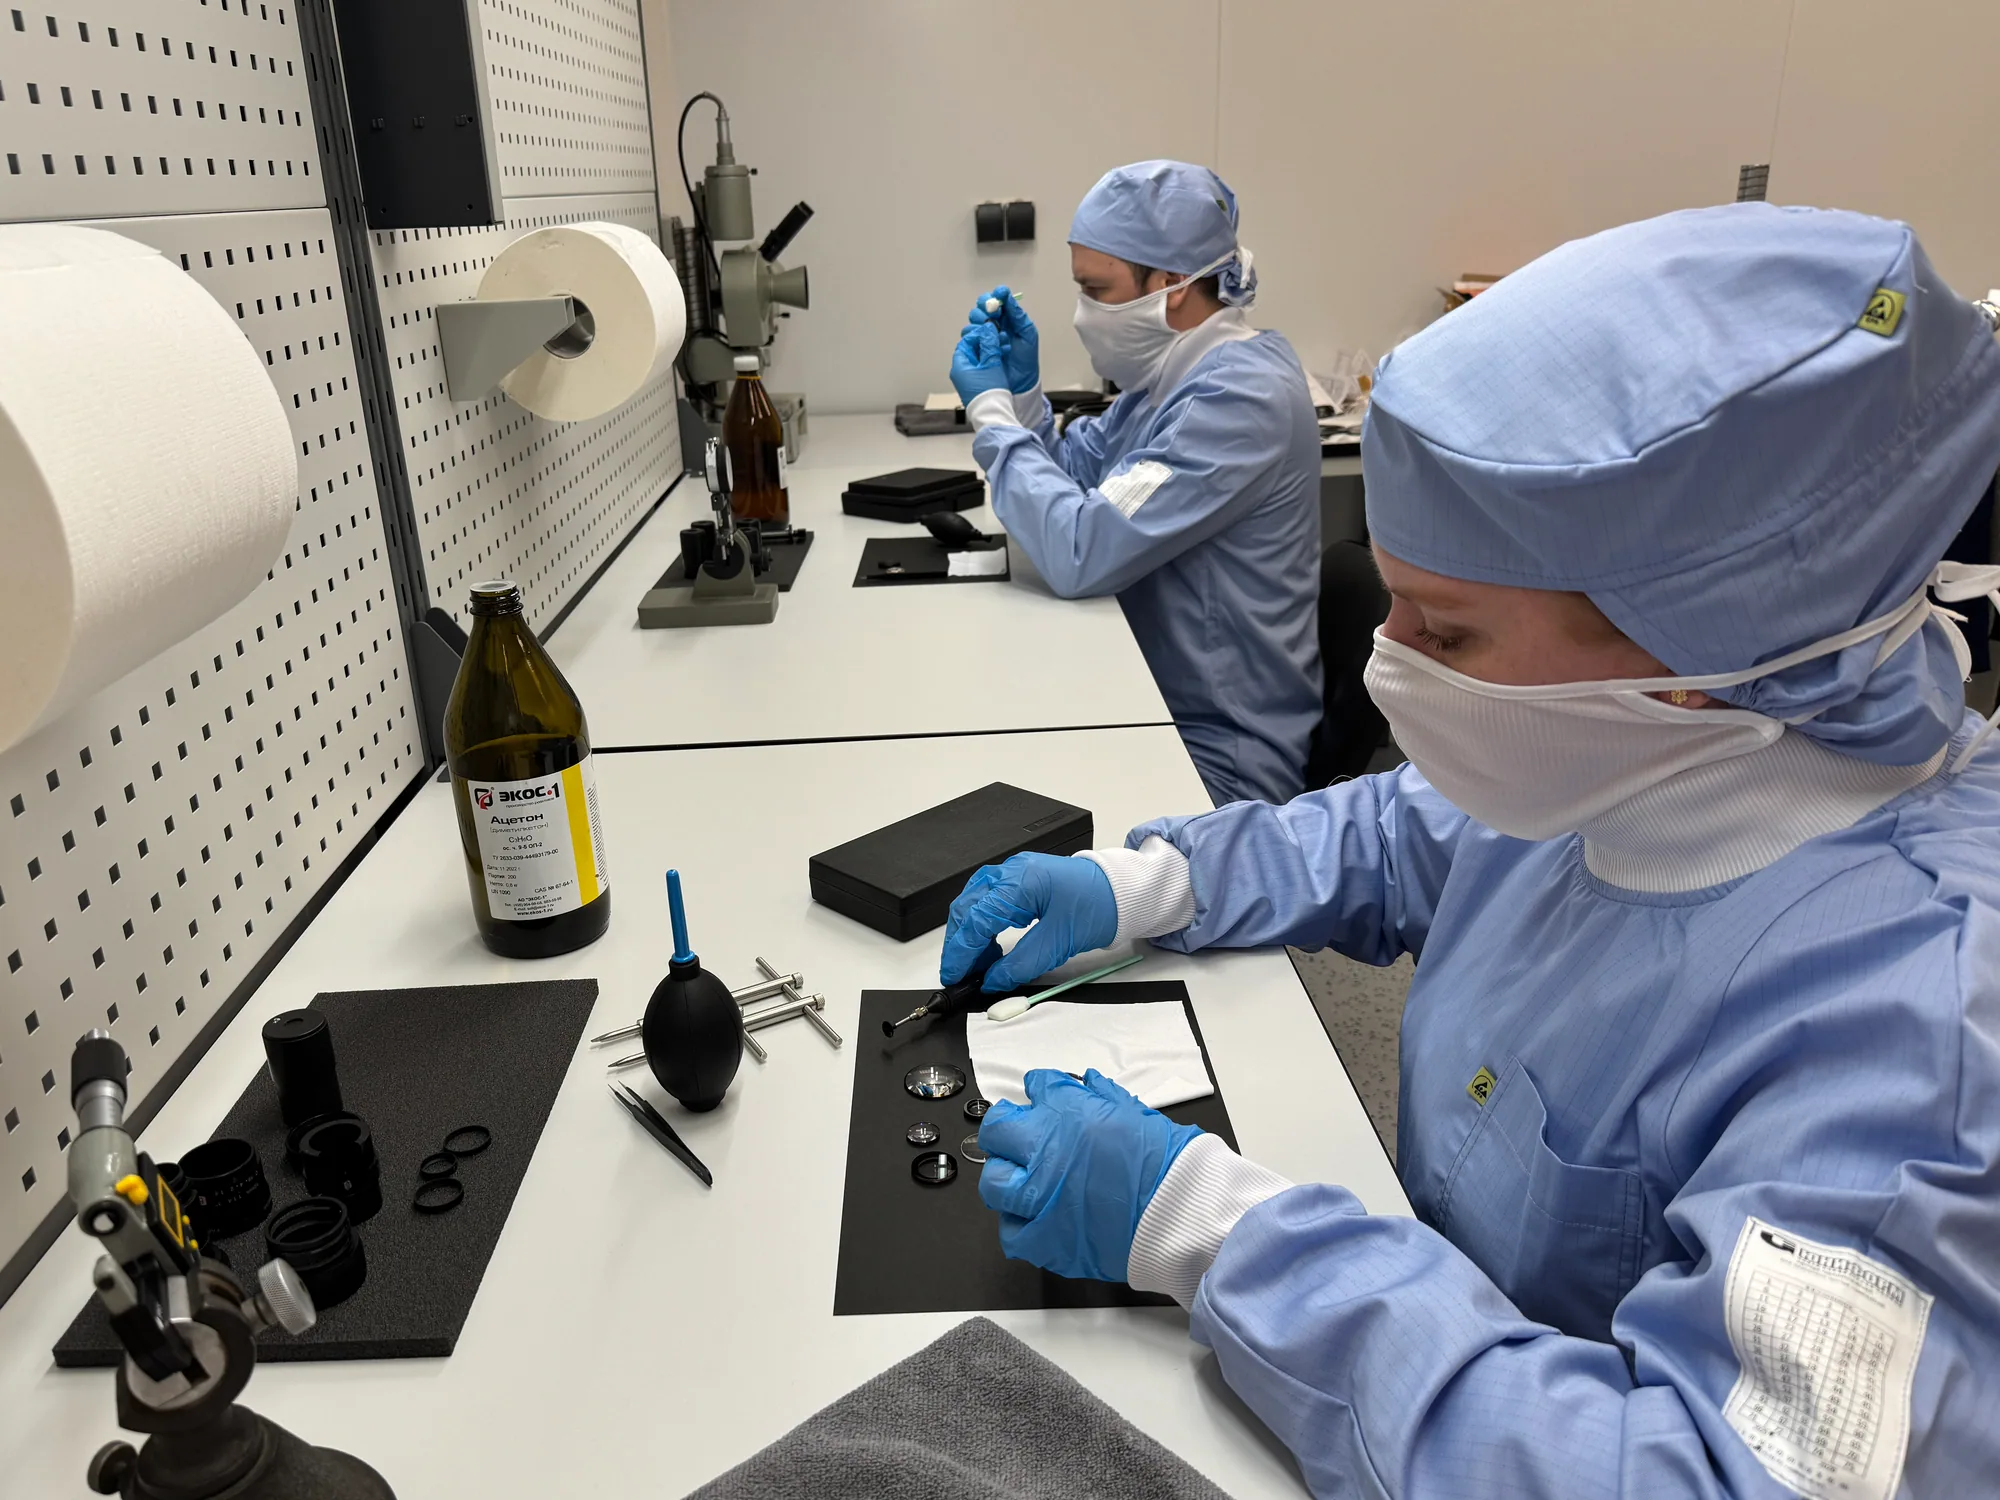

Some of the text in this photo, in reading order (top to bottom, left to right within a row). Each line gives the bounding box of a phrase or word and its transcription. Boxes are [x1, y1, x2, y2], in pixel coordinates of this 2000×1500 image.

[491, 814, 544, 825] Ацетон
[555, 880, 574, 889] 67-64-1
[517, 908, 553, 916] www.ekos-1.ru
